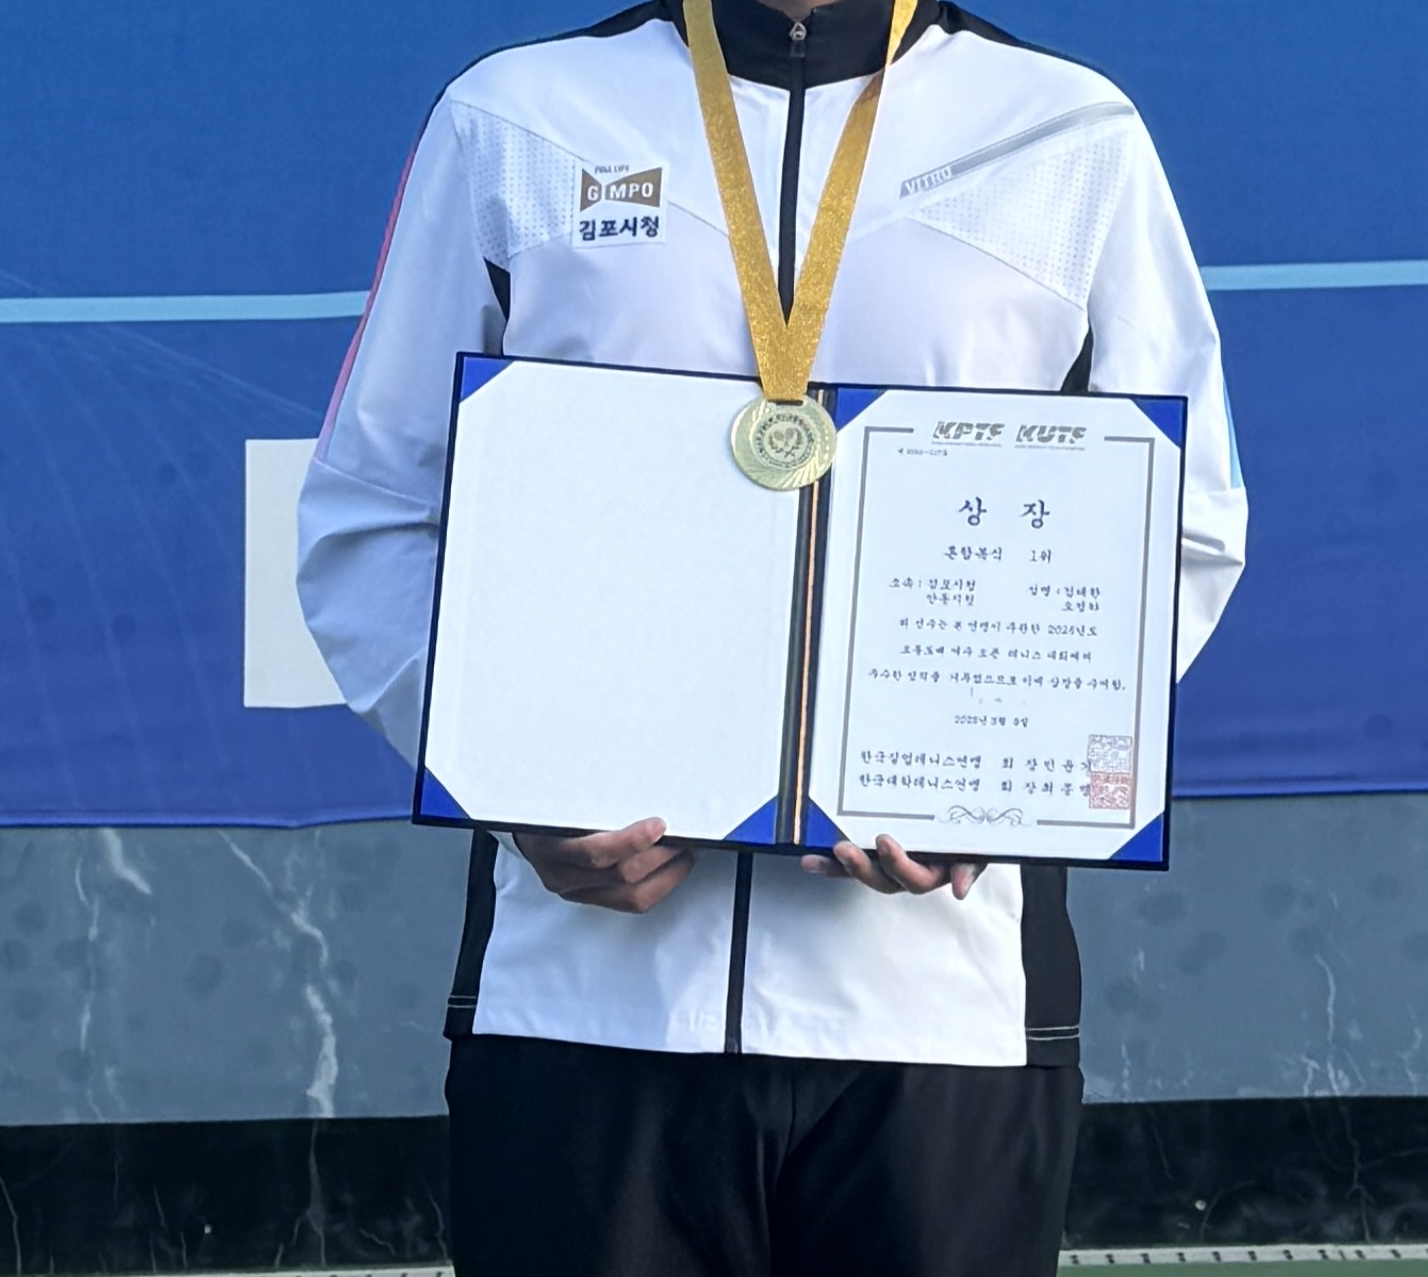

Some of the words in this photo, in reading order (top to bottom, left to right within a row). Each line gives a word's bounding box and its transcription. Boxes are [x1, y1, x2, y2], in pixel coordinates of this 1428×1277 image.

[905, 166, 952, 195] VITRO
[578, 215, 661, 242] 김포시청
[1015, 423, 1087, 444] KUTF
[958, 496, 987, 526] 상
[1020, 499, 1051, 529] 장
